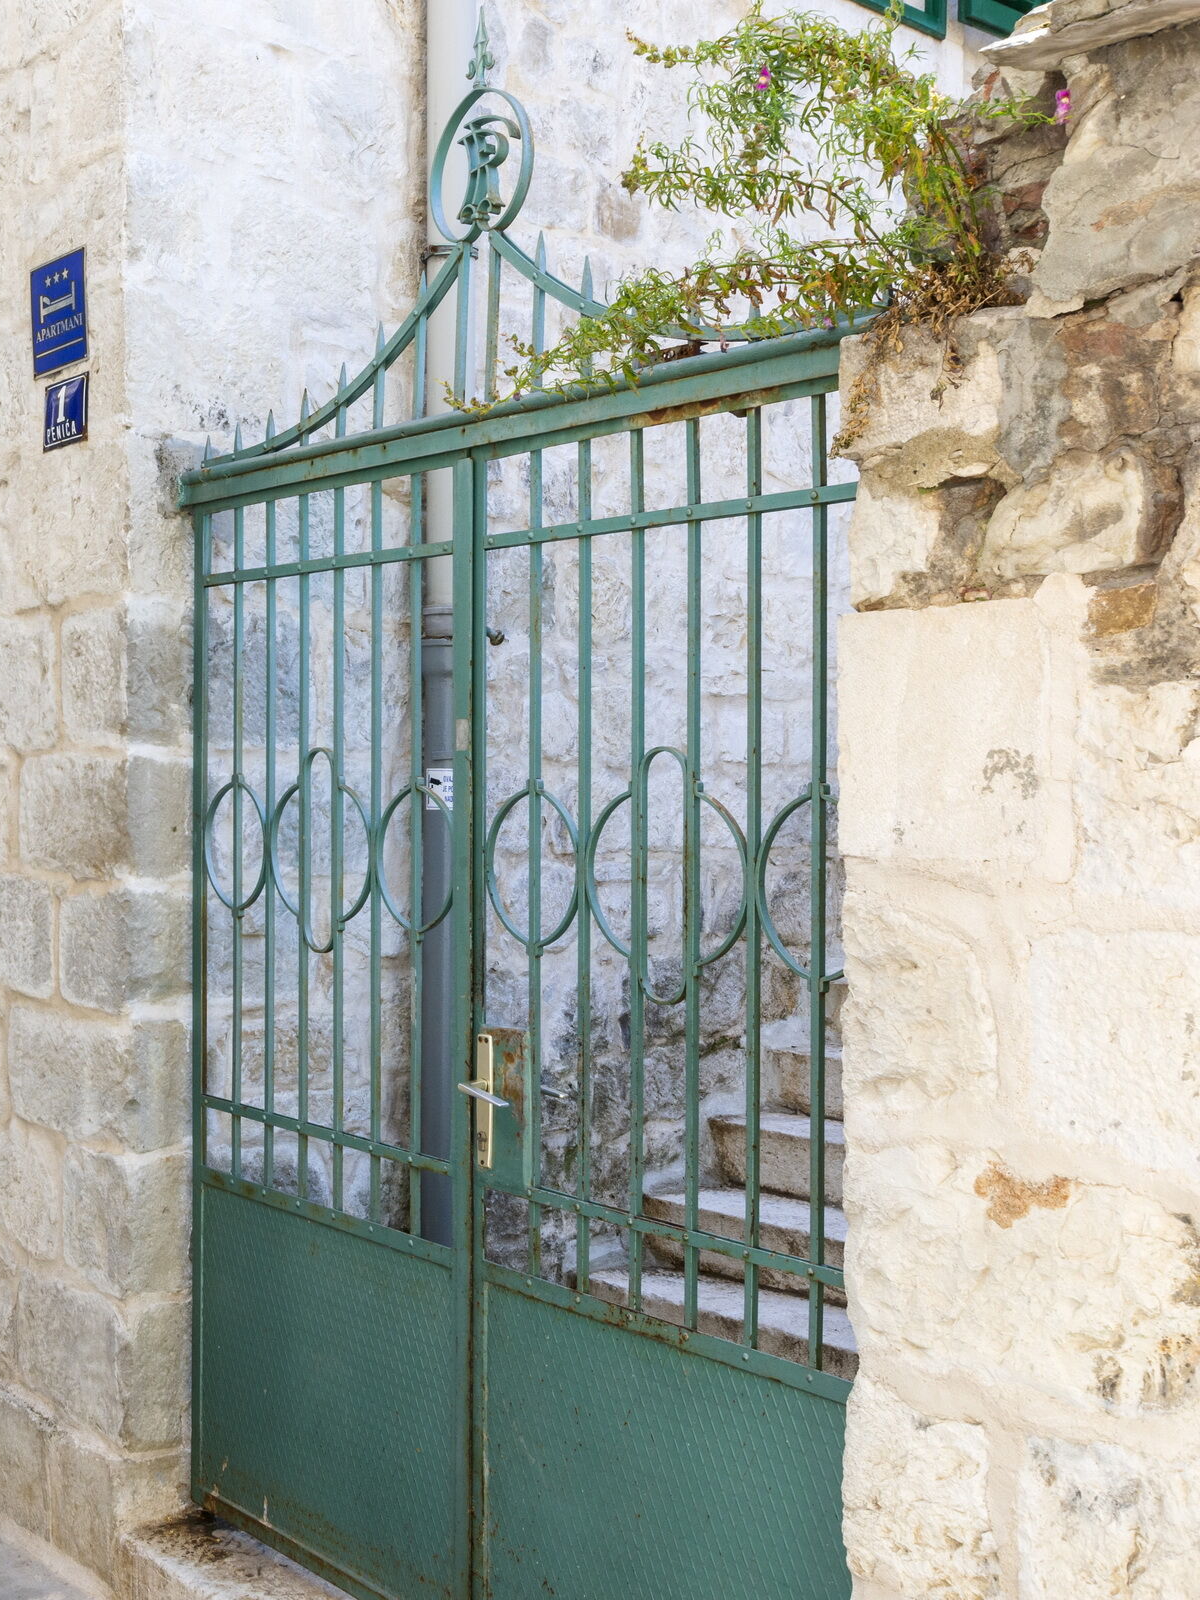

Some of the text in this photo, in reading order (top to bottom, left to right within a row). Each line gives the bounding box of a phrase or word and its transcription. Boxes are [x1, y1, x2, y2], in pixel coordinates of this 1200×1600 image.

[35, 312, 84, 344] APARTMANI
[56, 385, 67, 423] 1
[46, 418, 77, 445] PENIĆA
